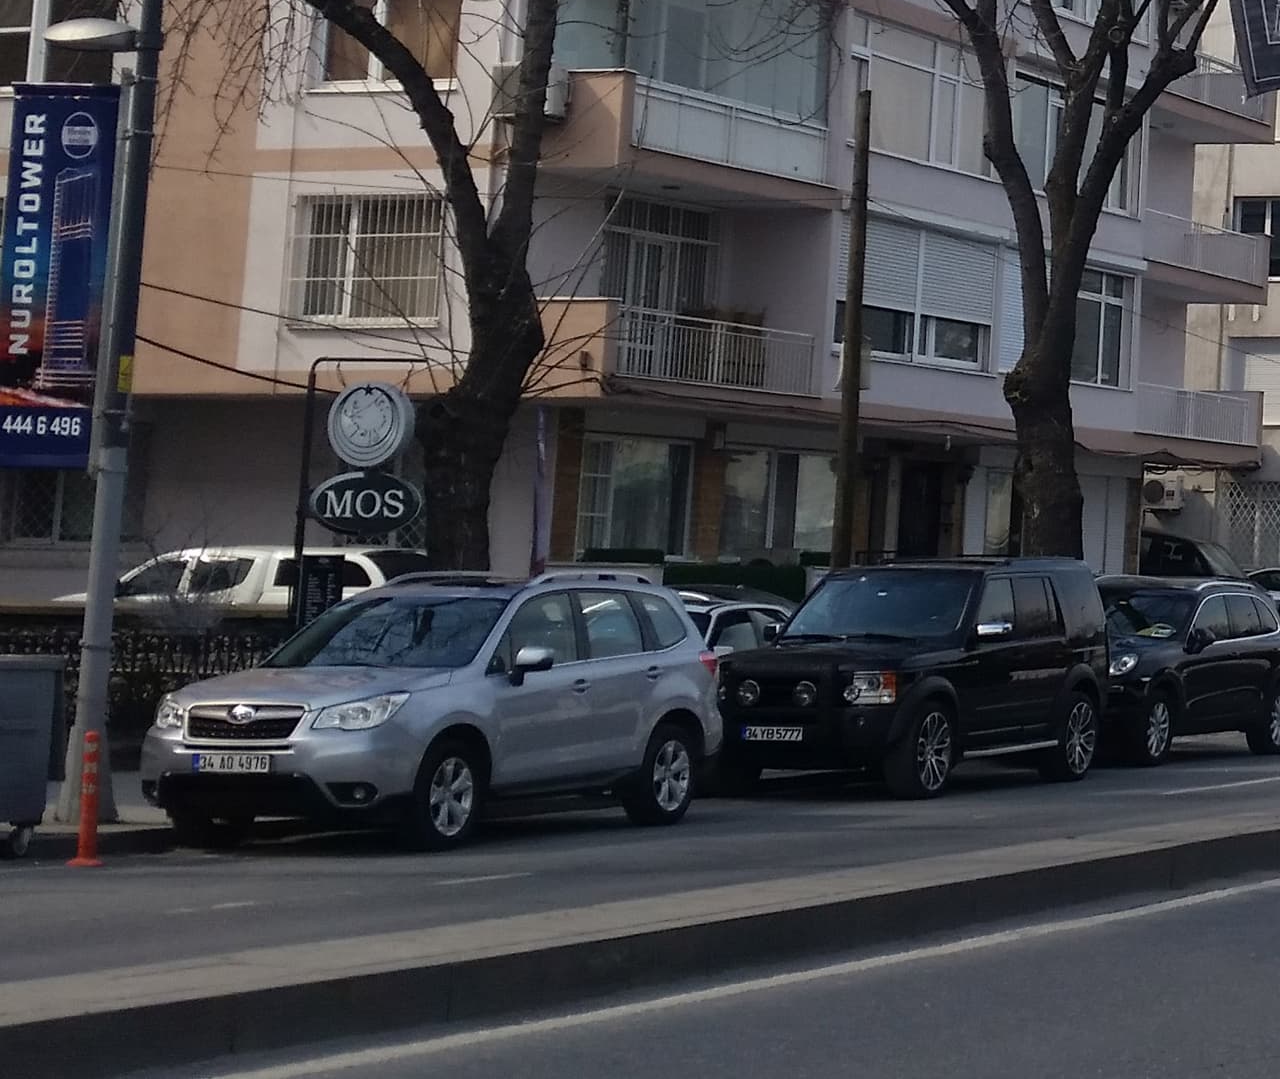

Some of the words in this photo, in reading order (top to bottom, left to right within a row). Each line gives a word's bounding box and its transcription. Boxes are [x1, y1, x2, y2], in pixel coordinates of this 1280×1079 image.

[8, 113, 47, 356] NUROLTOWER
[2, 415, 33, 433] 444
[36, 416, 46, 434] 6
[50, 417, 81, 436] 496
[323, 489, 405, 518] MOS
[200, 756, 214, 770] 34
